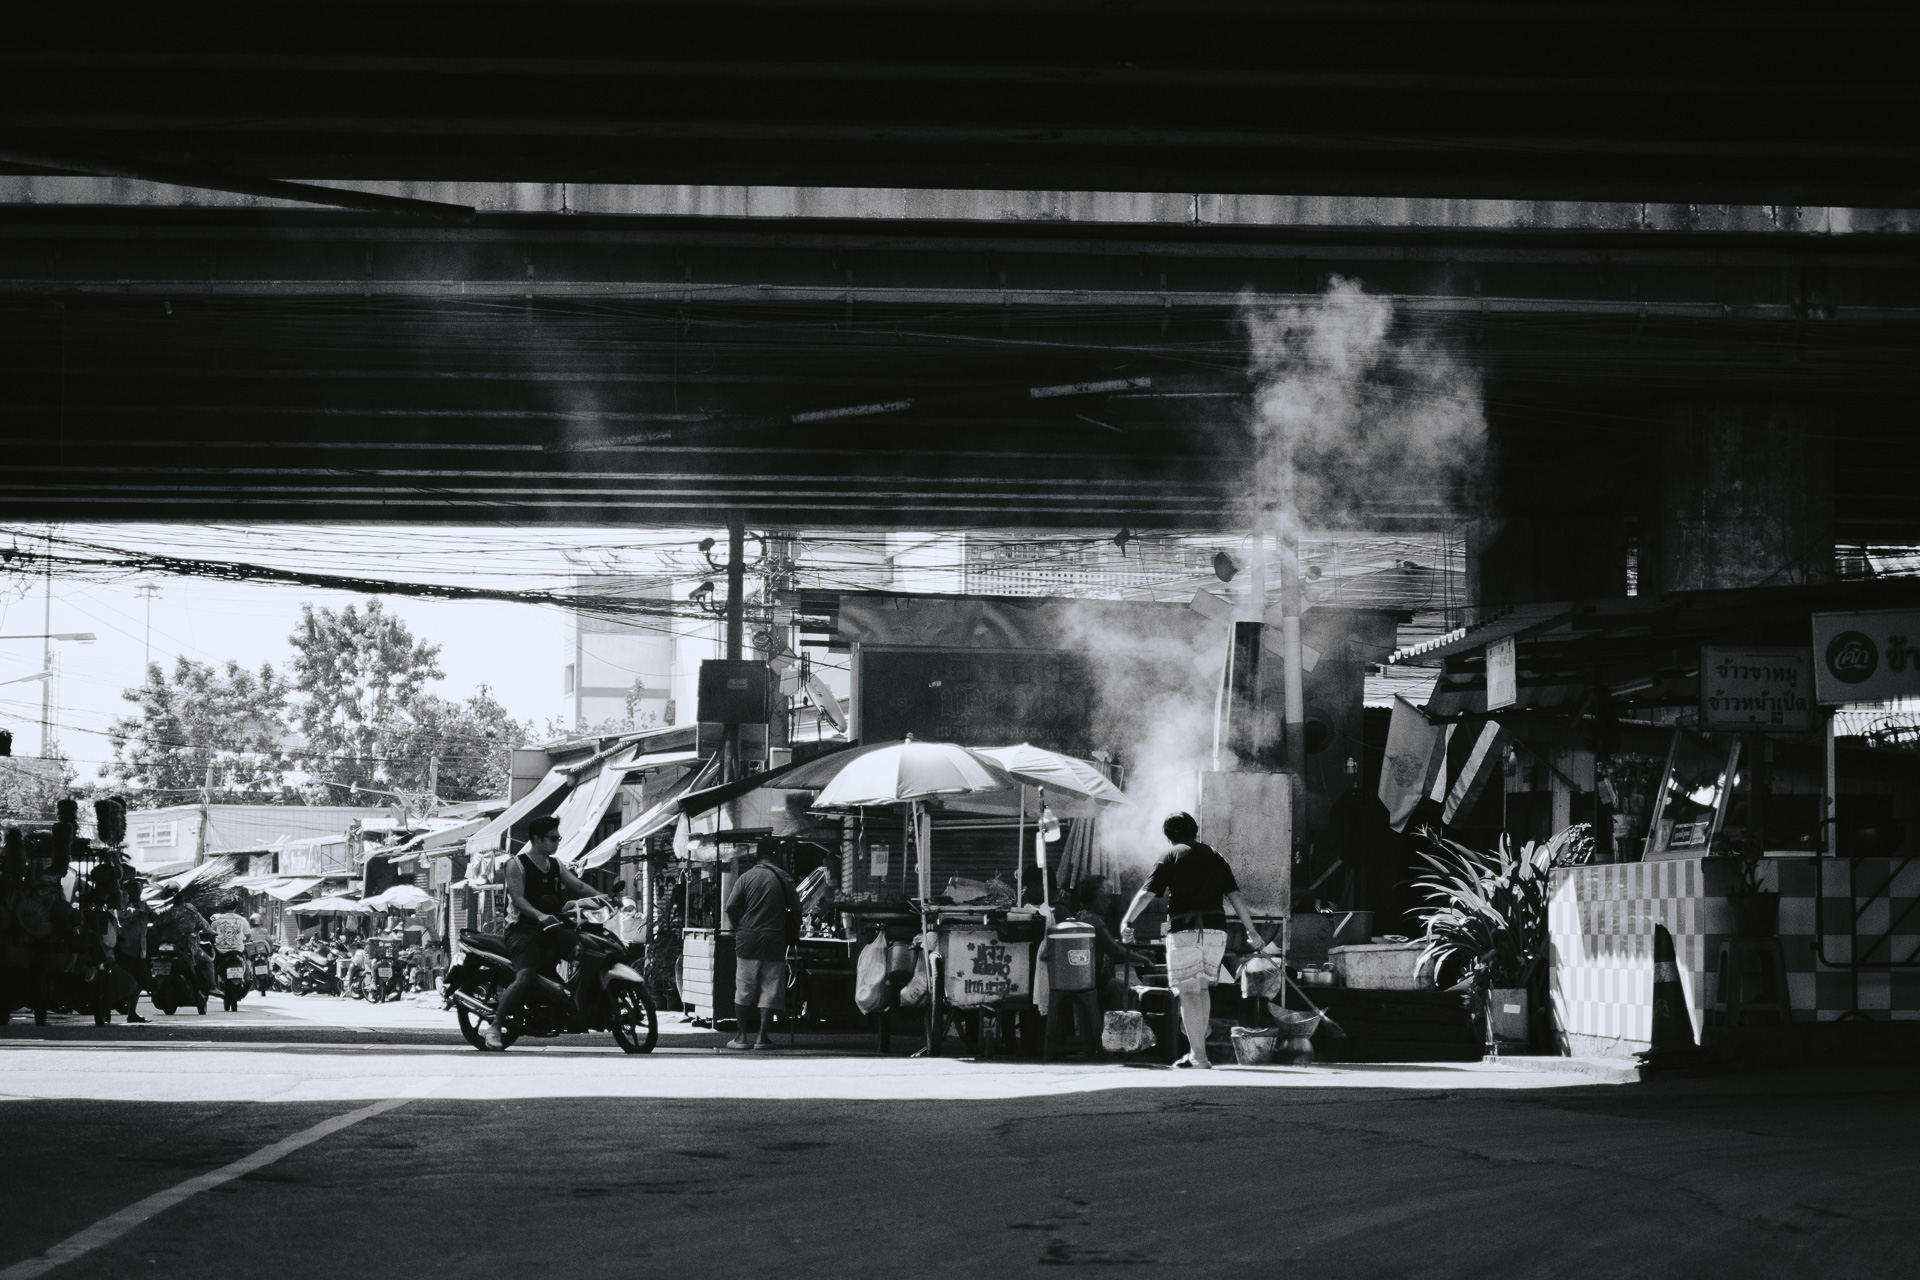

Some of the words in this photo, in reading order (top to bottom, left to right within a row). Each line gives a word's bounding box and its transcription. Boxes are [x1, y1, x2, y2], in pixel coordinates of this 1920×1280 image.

[1716, 658, 1797, 687] ข้าวขาหมู
[1708, 689, 1807, 711] ข้าวหน้าเป็ด
